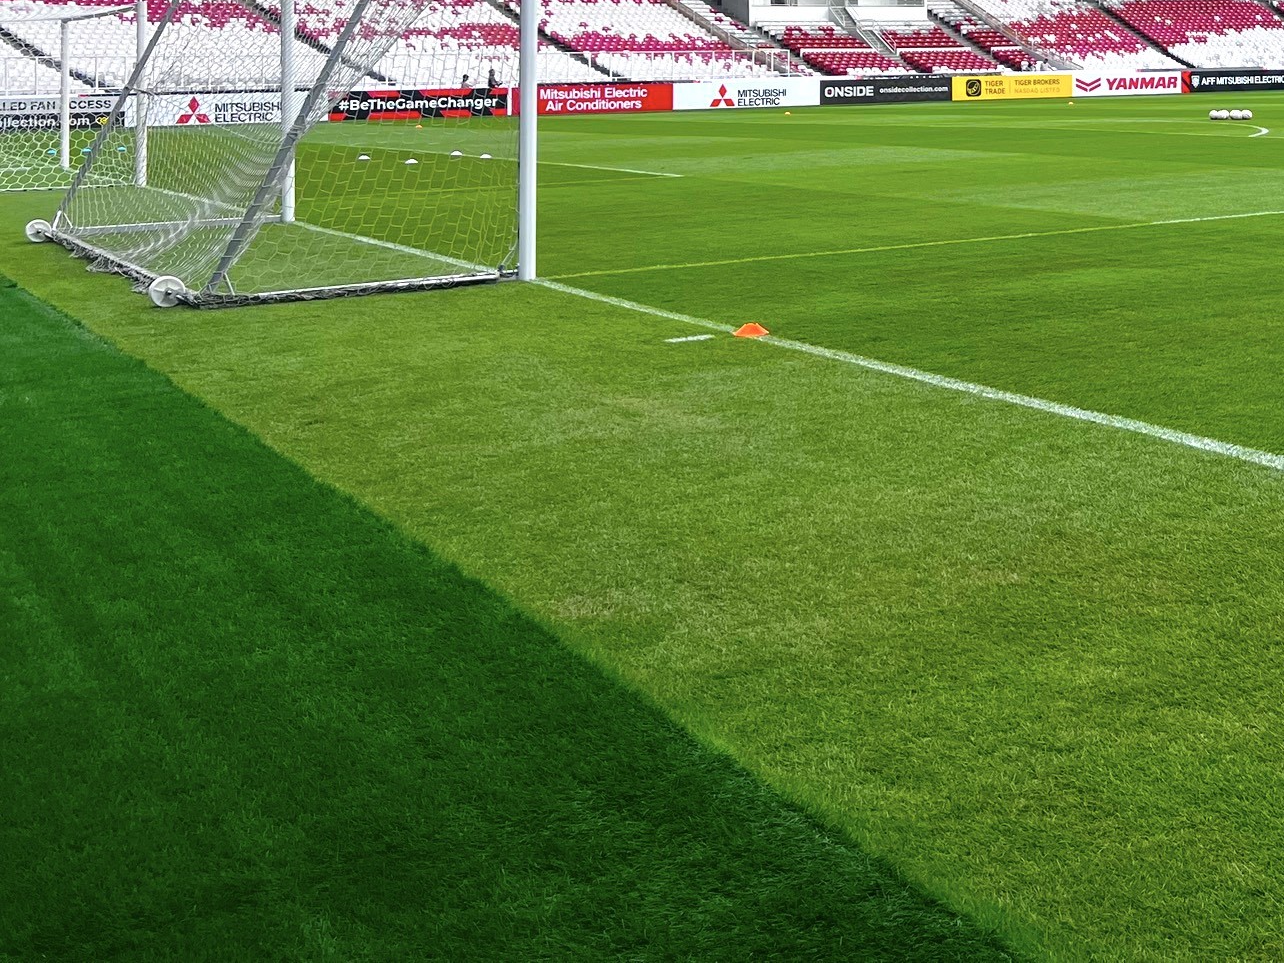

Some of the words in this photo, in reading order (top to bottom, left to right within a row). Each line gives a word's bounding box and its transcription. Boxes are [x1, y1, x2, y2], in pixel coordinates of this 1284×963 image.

[1033, 78, 1060, 86] BROKERS
[1106, 76, 1178, 91] YANMAR
[1201, 77, 1216, 86] AFF
[1216, 76, 1254, 85] MITSUBISHI
[540, 87, 601, 99] Mitsubishi
[604, 87, 648, 98] Electric
[737, 88, 787, 98] MITSUBISHI
[824, 85, 874, 98] ONSIDE
[879, 85, 948, 94] onsidecollection.com
[1014, 86, 1038, 94] NASDAQ
[30, 101, 56, 111] FAN
[59, 100, 112, 110] CCESS
[338, 97, 498, 111] #BeTheGameChanger
[545, 100, 563, 111] Air
[566, 99, 642, 111] Conditioners
[737, 97, 780, 107] ELECTRIC
[215, 112, 274, 123] ELECTRIC
